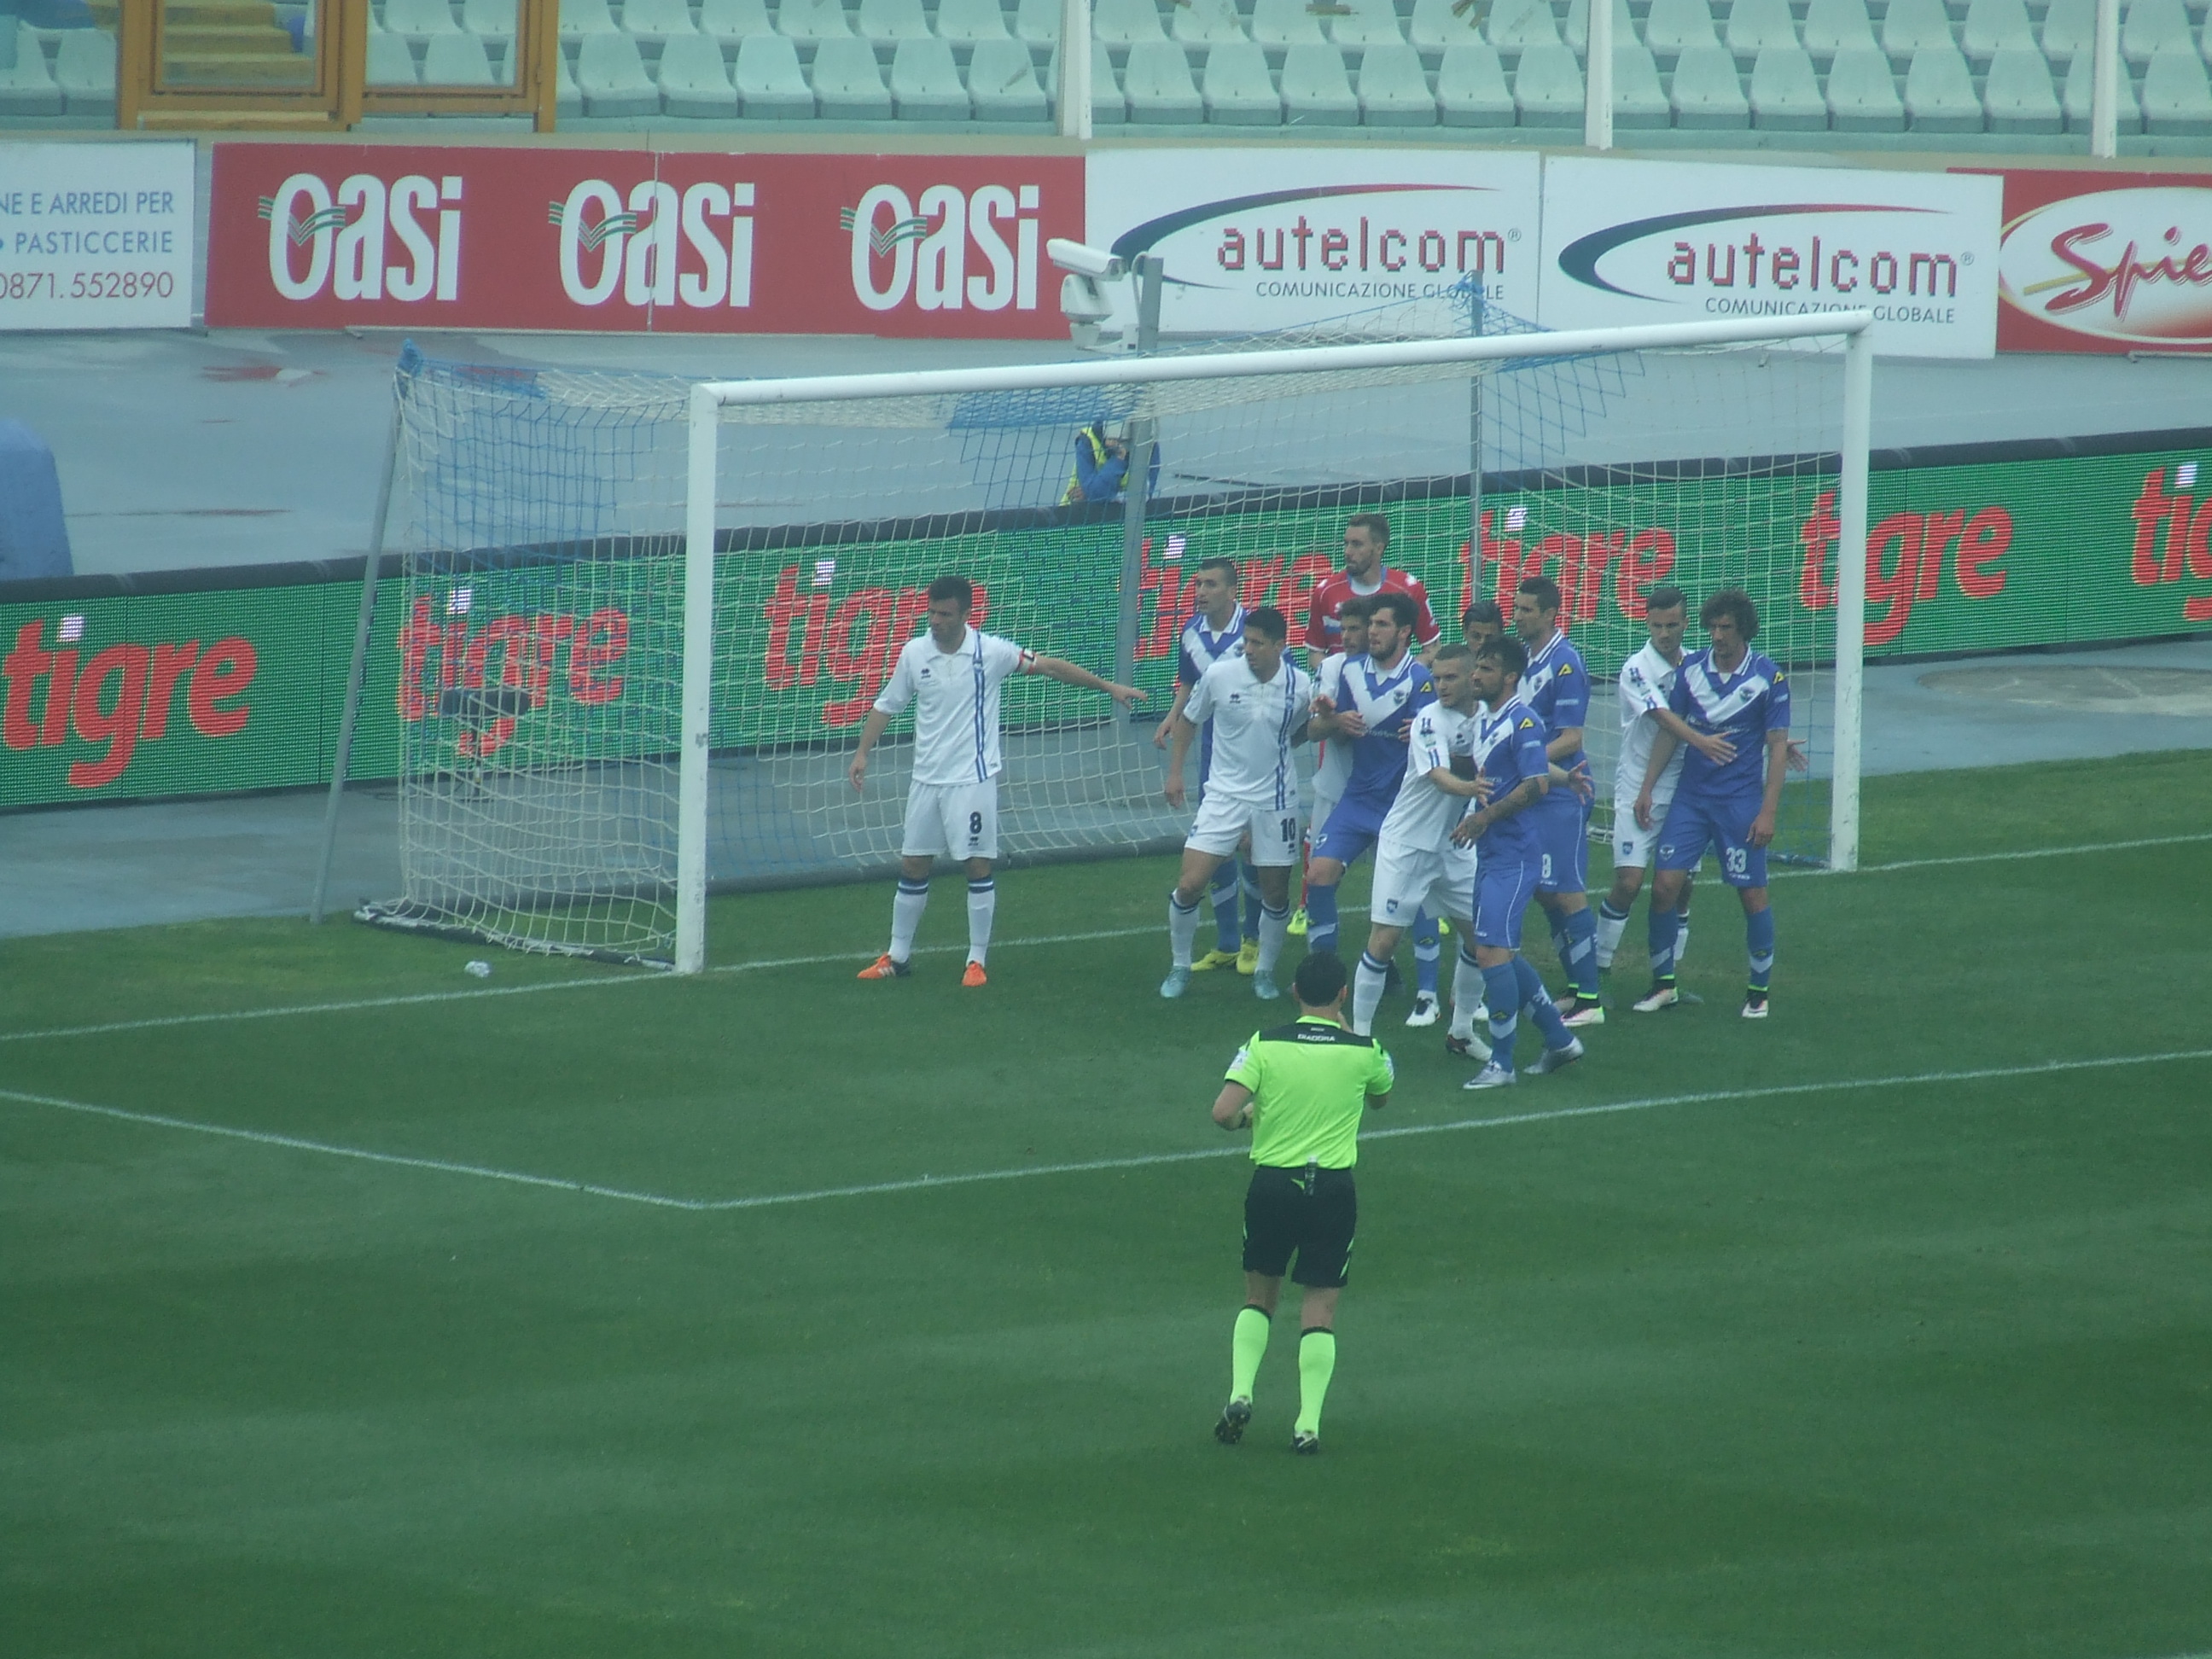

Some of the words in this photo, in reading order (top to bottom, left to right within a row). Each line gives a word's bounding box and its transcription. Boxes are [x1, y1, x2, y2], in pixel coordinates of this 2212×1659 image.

[32, 193, 42, 213] E
[49, 192, 127, 214] ARREDI
[136, 191, 173, 213] PER
[15, 230, 172, 253] PASTICCERIE
[269, 173, 462, 301] Oasi
[560, 179, 754, 308] Oasi
[852, 183, 1039, 311] Oasi
[1218, 215, 1504, 273] autelcom
[1667, 233, 1957, 298] autelcom
[1256, 282, 1416, 298] COMUNICAZIONE
[1423, 283, 1504, 300] GLOLE
[1706, 297, 1866, 315] COMUNICAZIO
[1873, 306, 1955, 323] GLOBALE
[1800, 489, 2013, 646] tgre
[763, 560, 990, 728] tigr
[3, 614, 256, 789] tigre
[969, 811, 982, 834] 8
[1281, 818, 1295, 842] 10
